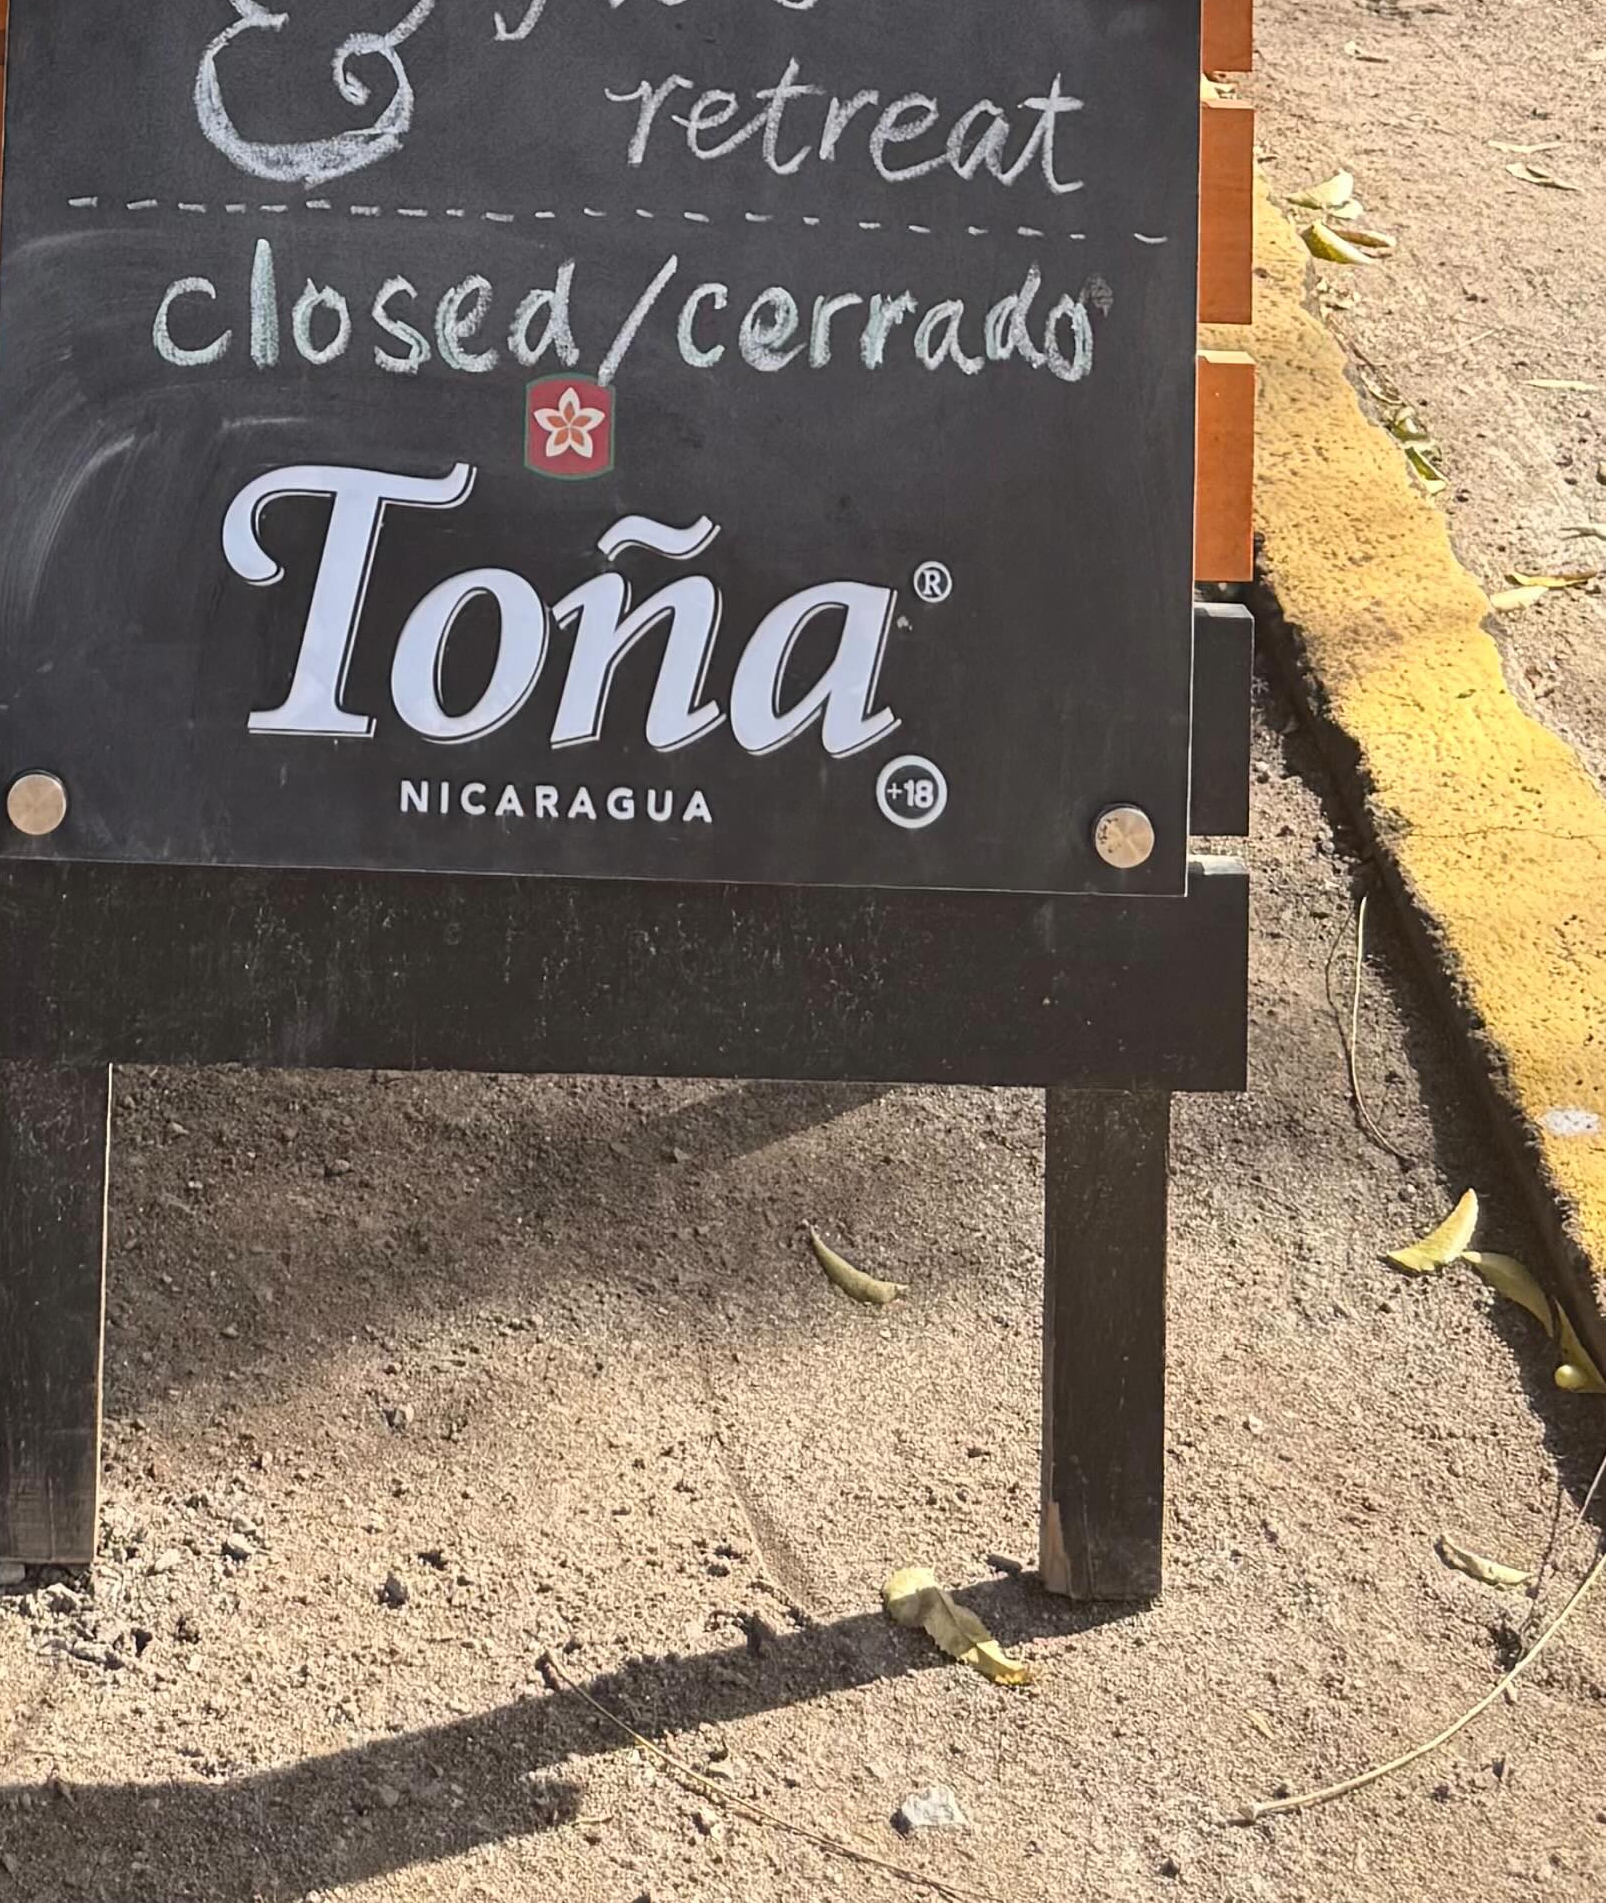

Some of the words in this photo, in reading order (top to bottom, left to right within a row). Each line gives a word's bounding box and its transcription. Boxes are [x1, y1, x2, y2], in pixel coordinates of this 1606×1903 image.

[604, 59, 1087, 193] retreat
[220, 461, 904, 759] Toña
[400, 778, 715, 824] NICARAGUA
[885, 776, 937, 810] +18
